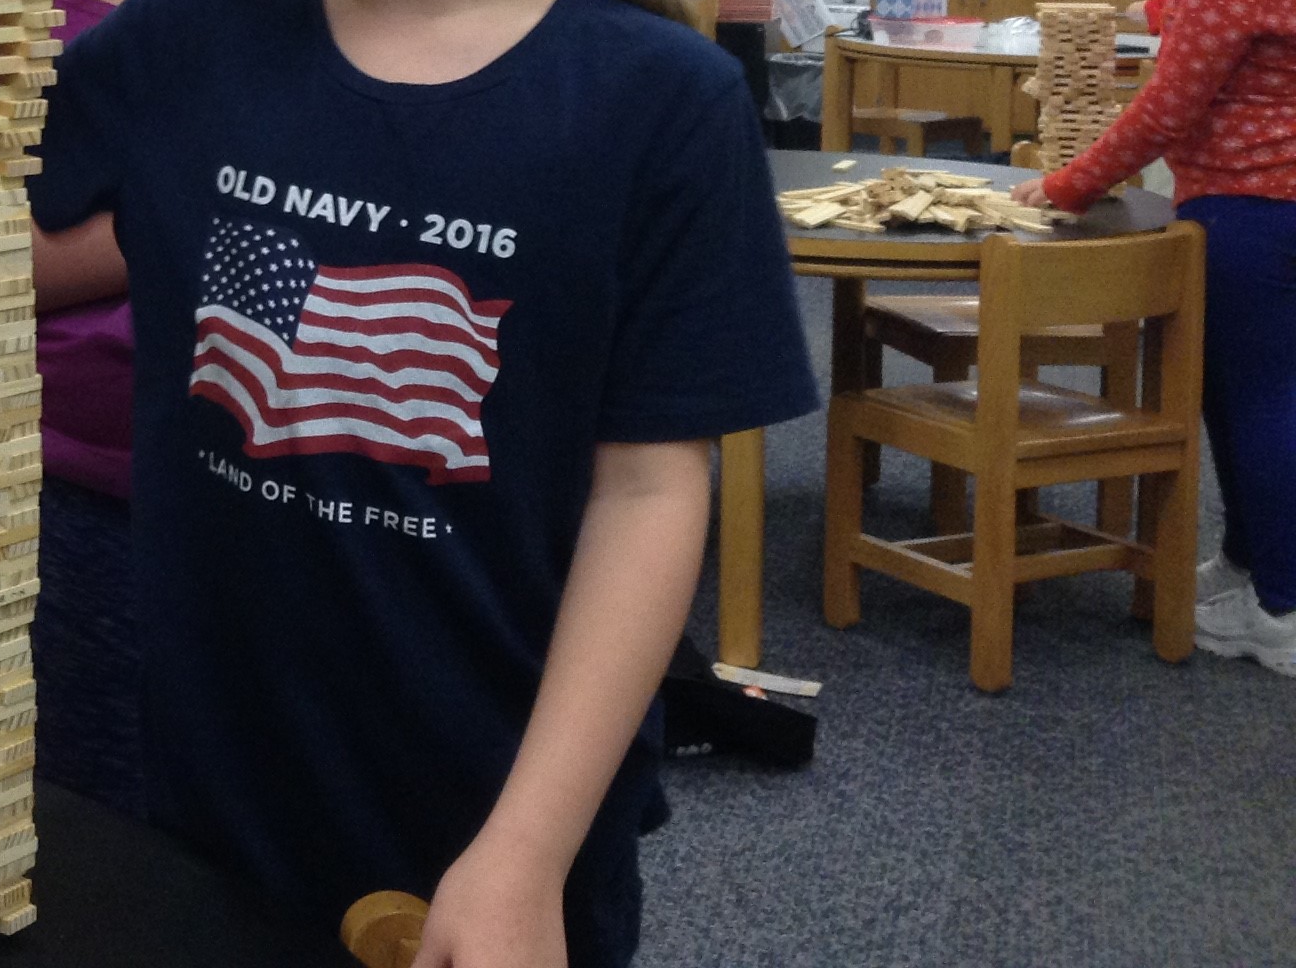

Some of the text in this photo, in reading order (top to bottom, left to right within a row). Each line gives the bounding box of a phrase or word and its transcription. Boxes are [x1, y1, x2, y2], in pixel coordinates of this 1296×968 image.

[216, 166, 519, 259] OLD NAVY 2016
[208, 452, 437, 539] LAND OF THE FREE
